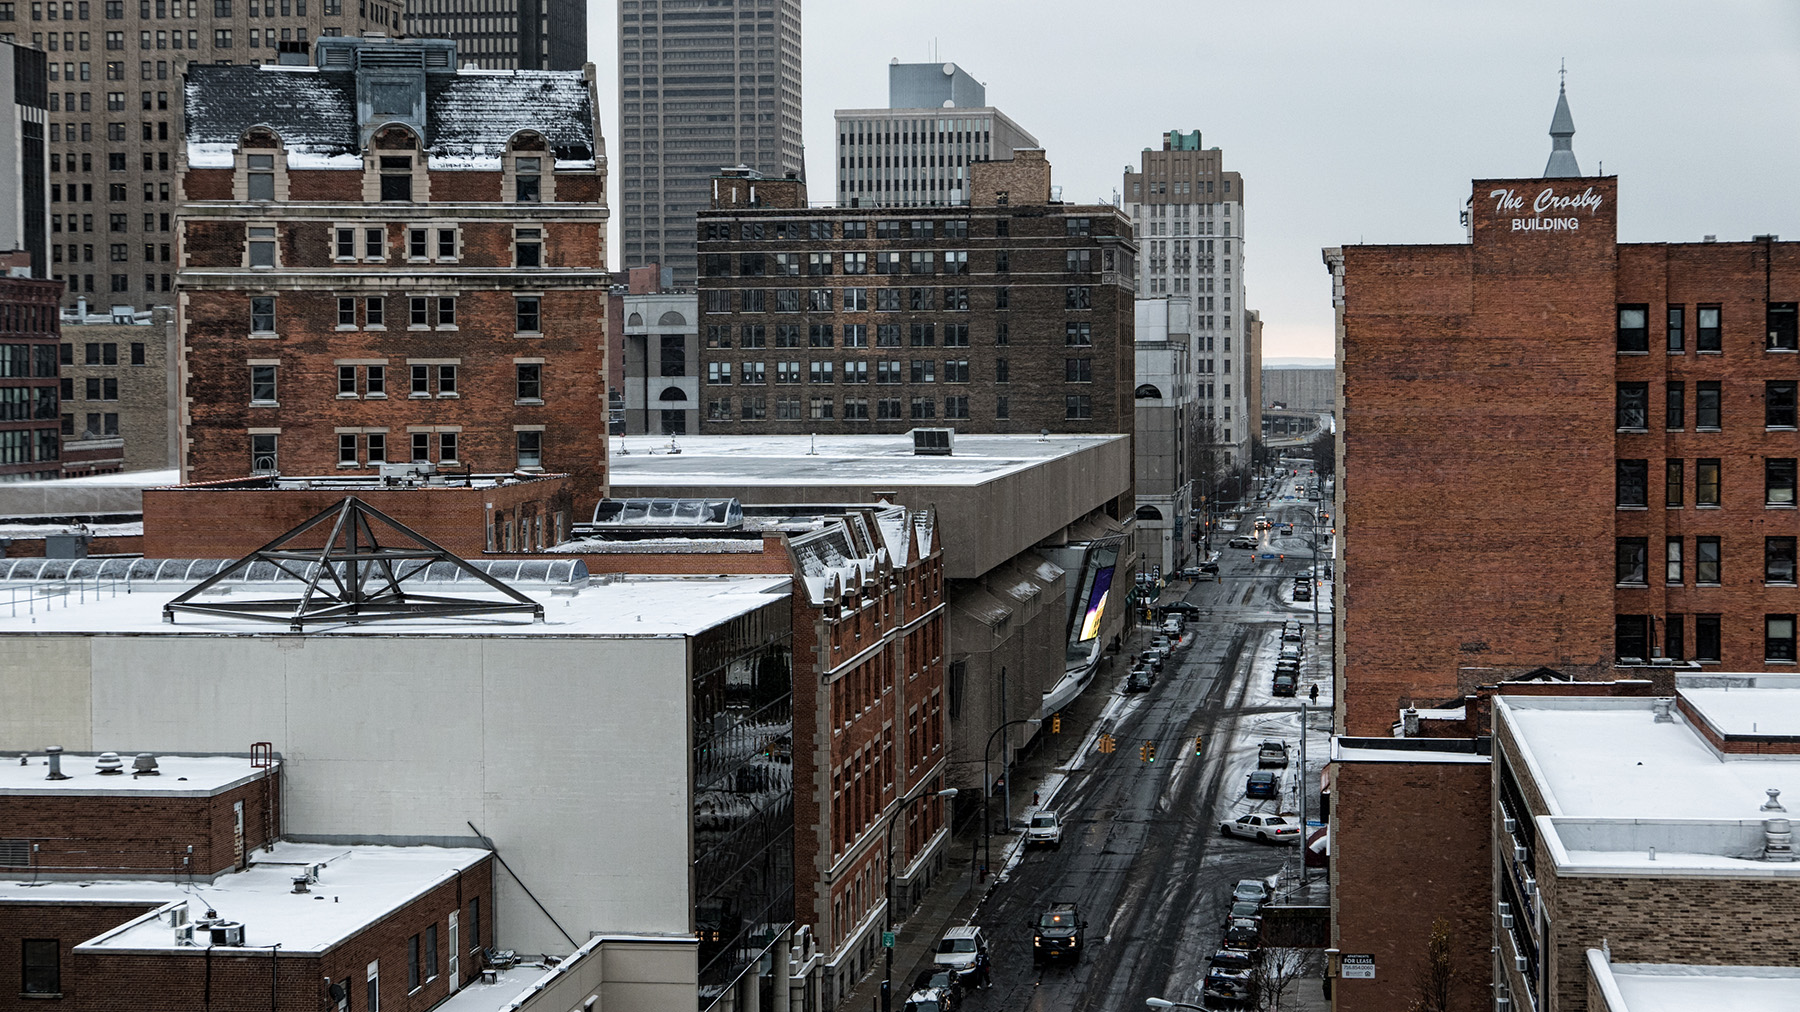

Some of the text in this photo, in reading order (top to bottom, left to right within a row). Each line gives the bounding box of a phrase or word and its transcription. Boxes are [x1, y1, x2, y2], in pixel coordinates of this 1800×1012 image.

[1490, 187, 1603, 213] The Crosby
[1511, 218, 1579, 230] BUILDING
